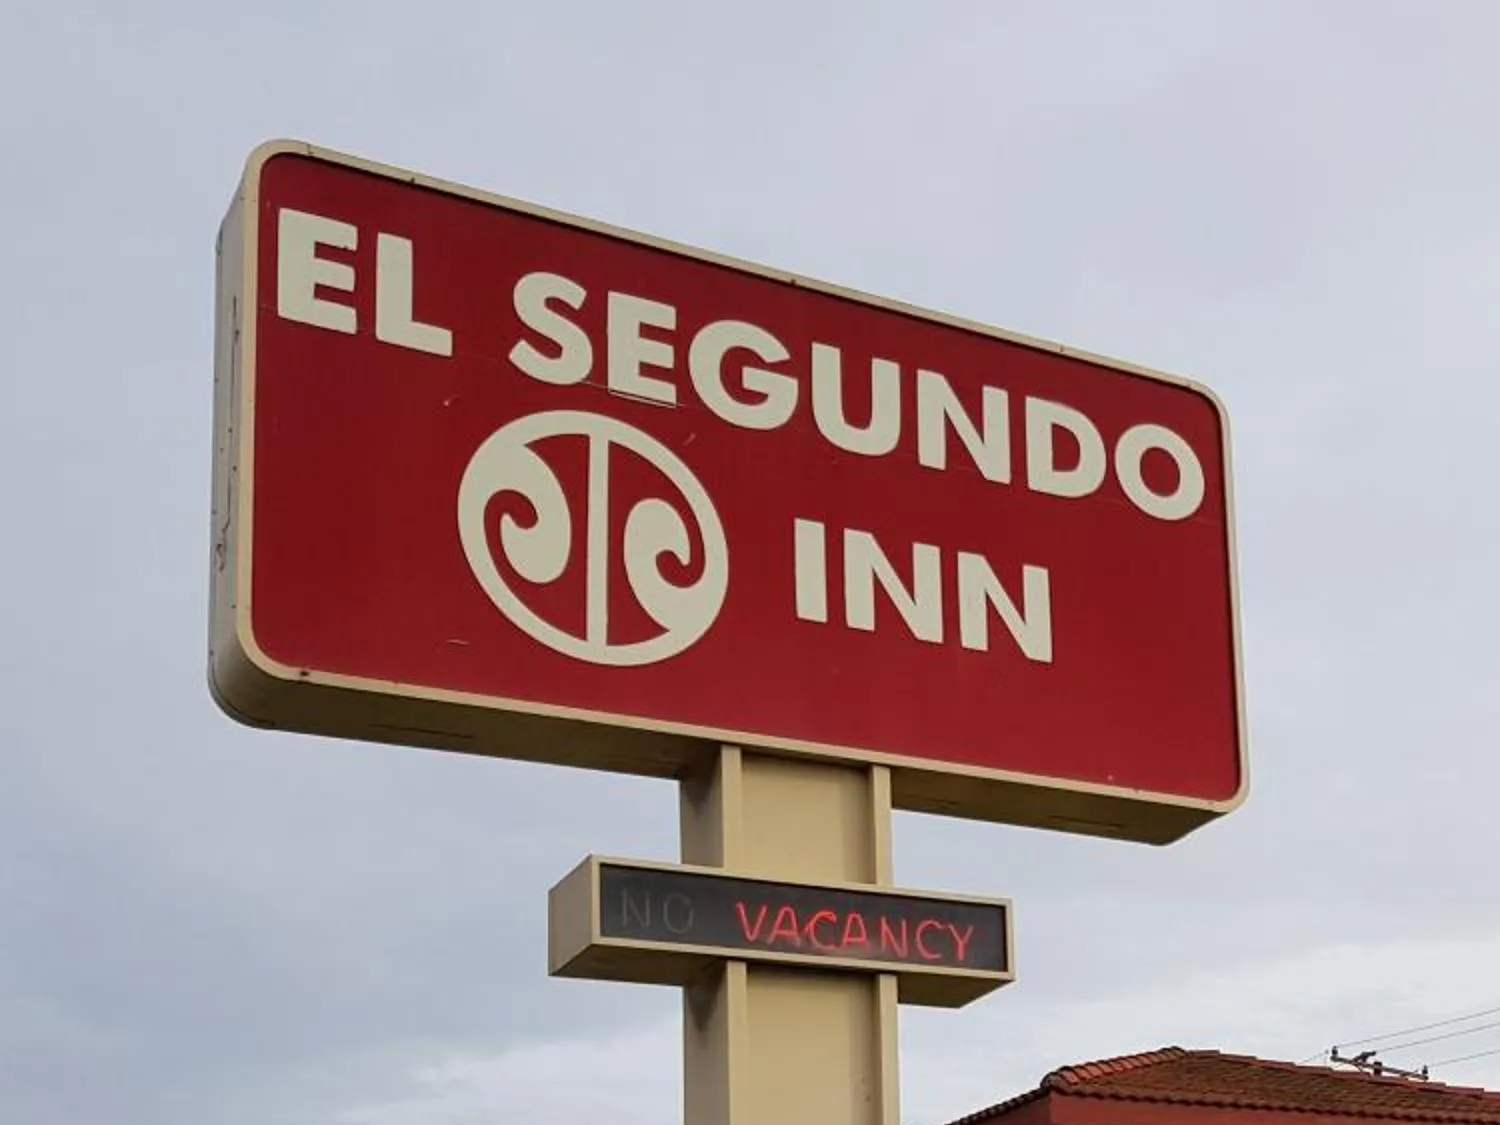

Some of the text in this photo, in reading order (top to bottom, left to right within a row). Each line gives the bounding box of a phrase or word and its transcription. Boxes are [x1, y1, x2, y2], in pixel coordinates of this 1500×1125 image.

[278, 208, 1205, 521] EL SEGUNDO
[794, 518, 1053, 663] INN
[620, 888, 973, 962] NO VACANCY
